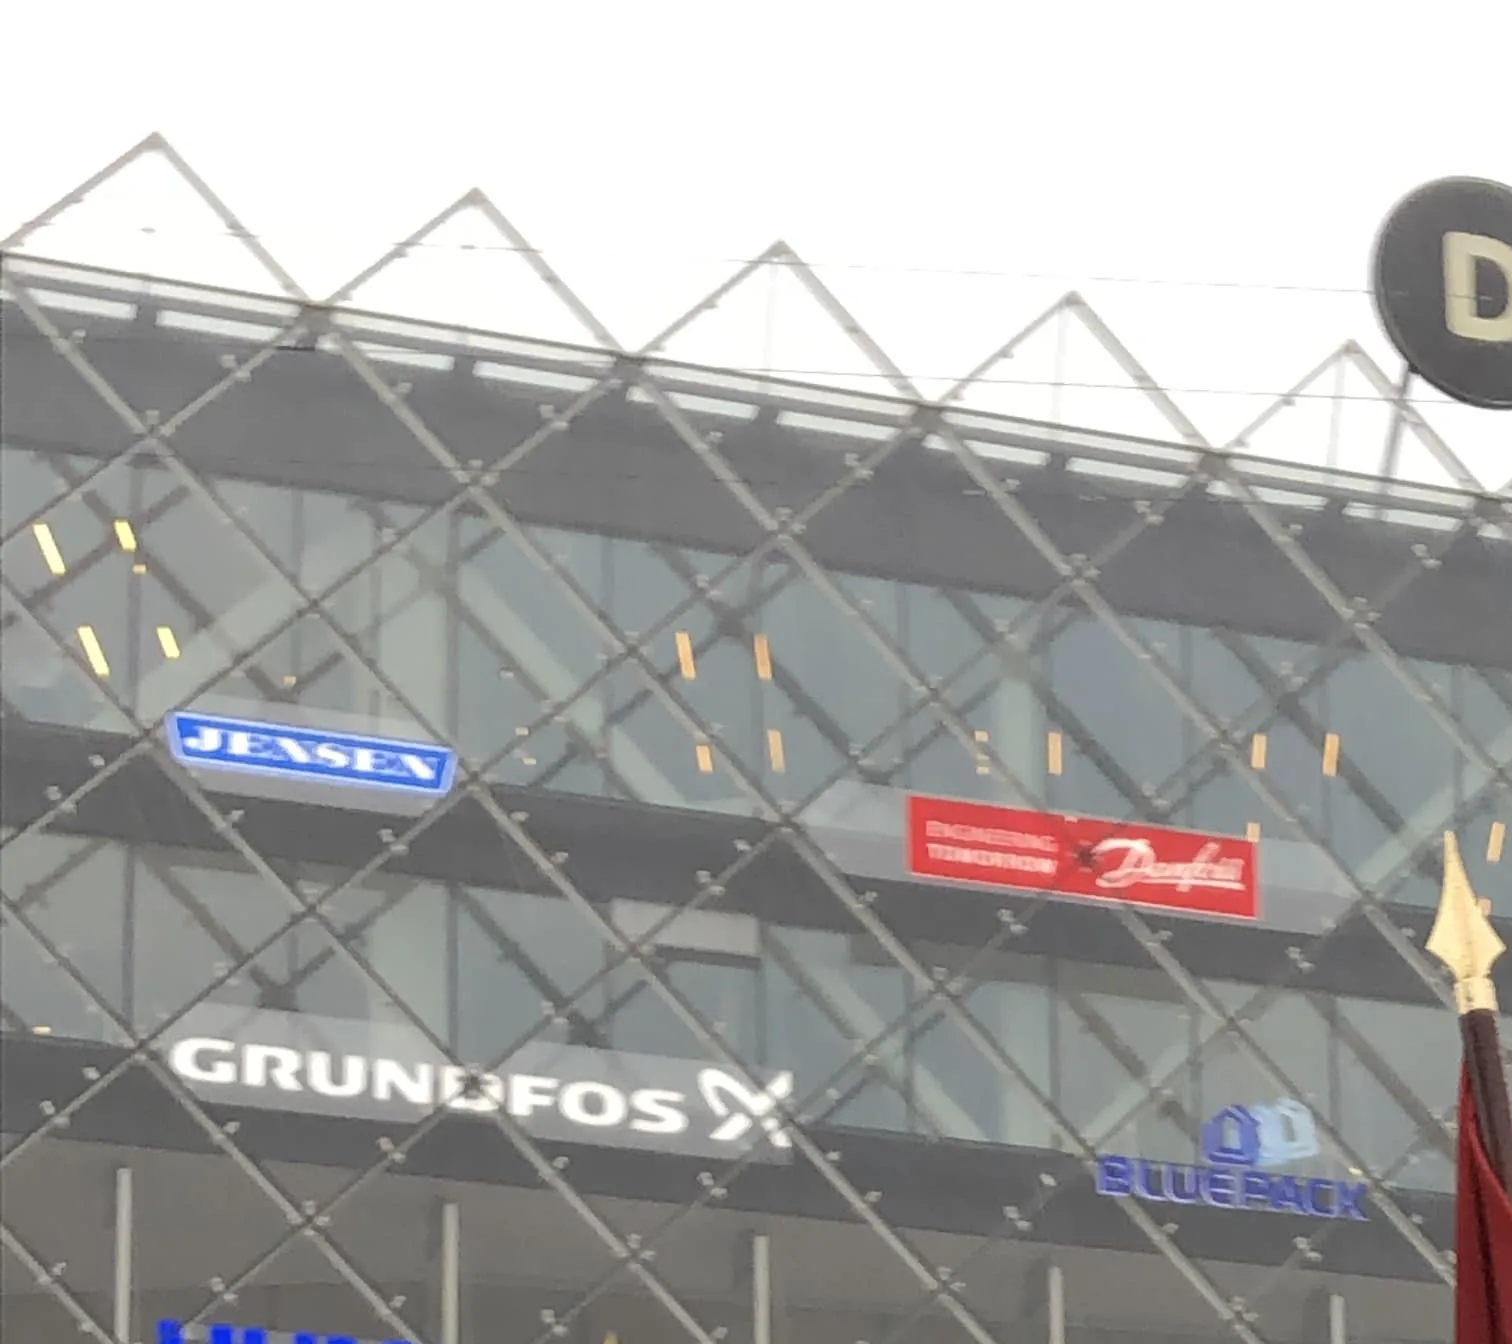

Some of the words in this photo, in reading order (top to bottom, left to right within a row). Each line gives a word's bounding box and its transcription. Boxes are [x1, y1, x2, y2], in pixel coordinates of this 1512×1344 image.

[181, 725, 438, 782] JENSEN
[171, 1036, 687, 1134] GRUNDFOS
[1097, 1155, 1369, 1221] BLUEPACK
